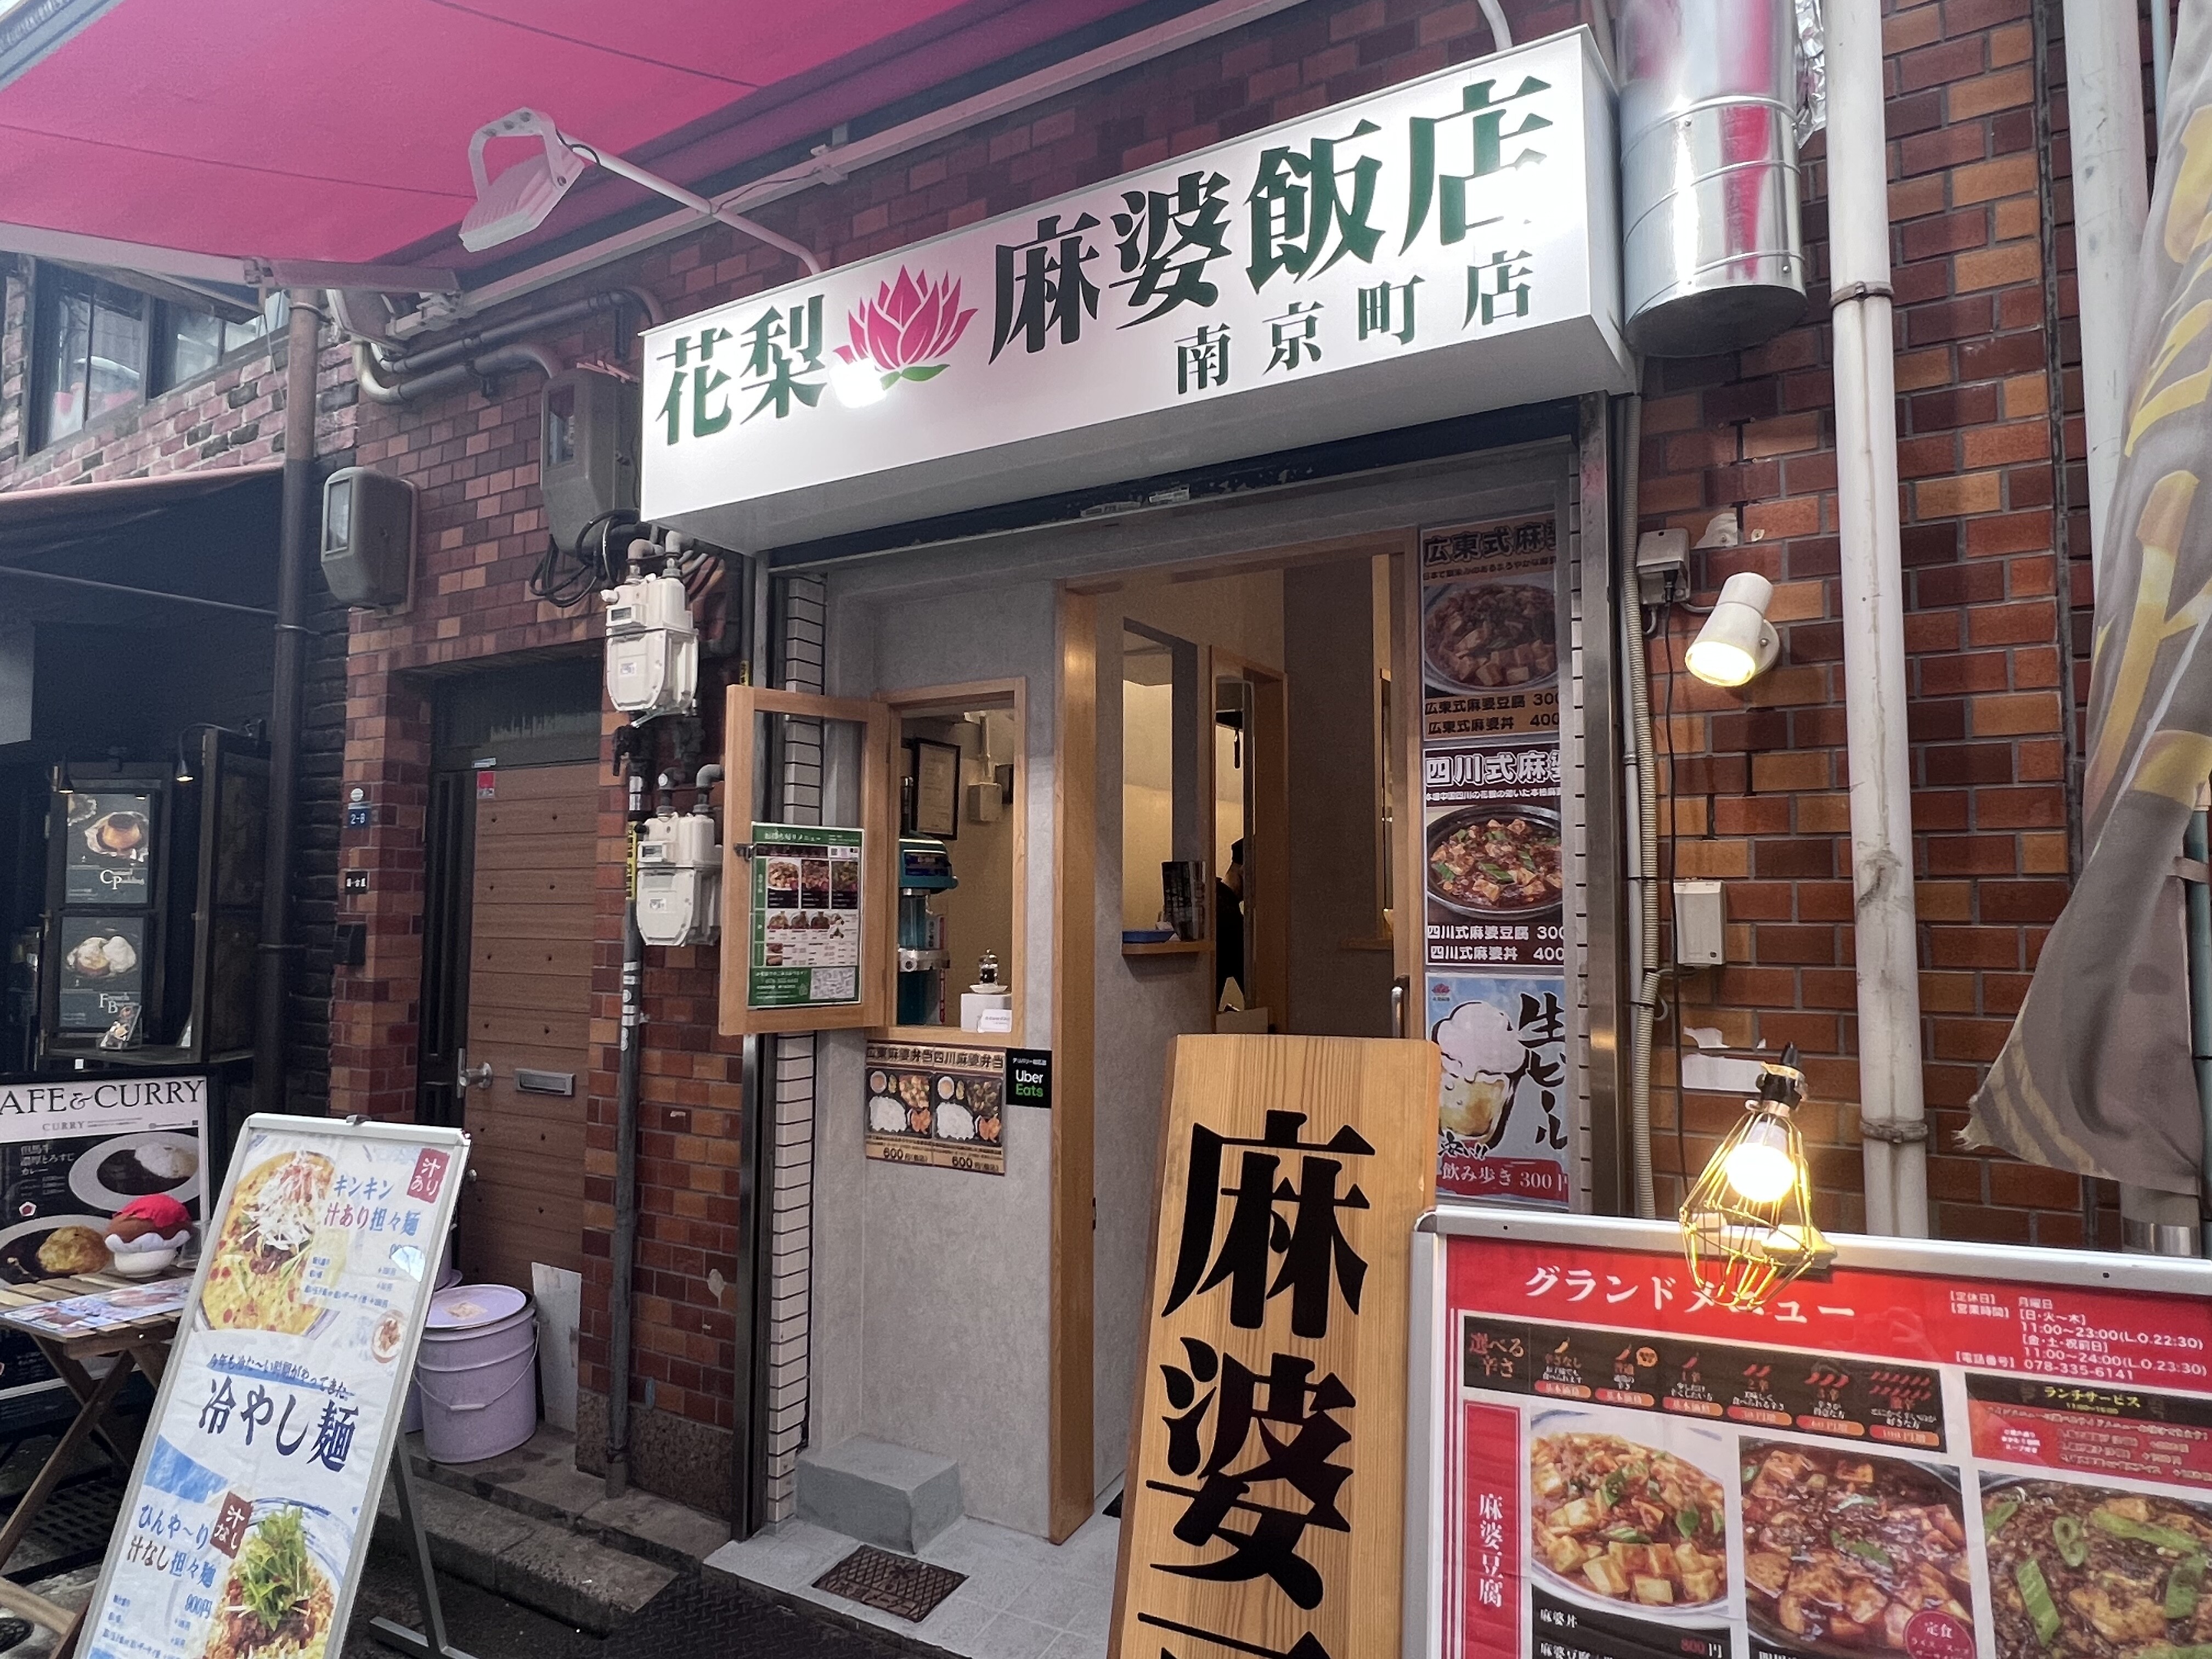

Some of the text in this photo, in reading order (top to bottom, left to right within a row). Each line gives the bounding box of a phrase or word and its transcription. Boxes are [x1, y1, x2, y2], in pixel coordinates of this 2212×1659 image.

[655, 76, 1553, 447] 花梨 麻婆飯店
[1175, 251, 1533, 397] 南京町店
[1425, 695, 1525, 715] 広東式麻婆豆腐
[1427, 925, 1530, 941] 四川式麻婆豆腐
[1431, 946, 1564, 961] 四川式麻婆丼 400
[1015, 1069, 1043, 1084] Uber
[1015, 1083, 1043, 1097] Eats
[42, 1120, 85, 1132] CURRY
[1442, 1161, 1512, 1187] 飲み歩き
[334, 1175, 395, 1200] キンキン
[324, 1201, 421, 1237] 汁あり担々麺
[1525, 1265, 1855, 1323] グランドメニュー
[1470, 1333, 1524, 1357] 選べる
[1137, 1109, 1376, 1659] 麻婆
[2044, 1386, 2141, 1408] ランチサービス
[199, 1375, 359, 1472] 冷やし麺
[1479, 1493, 1504, 1608] 麻婆豆腐
